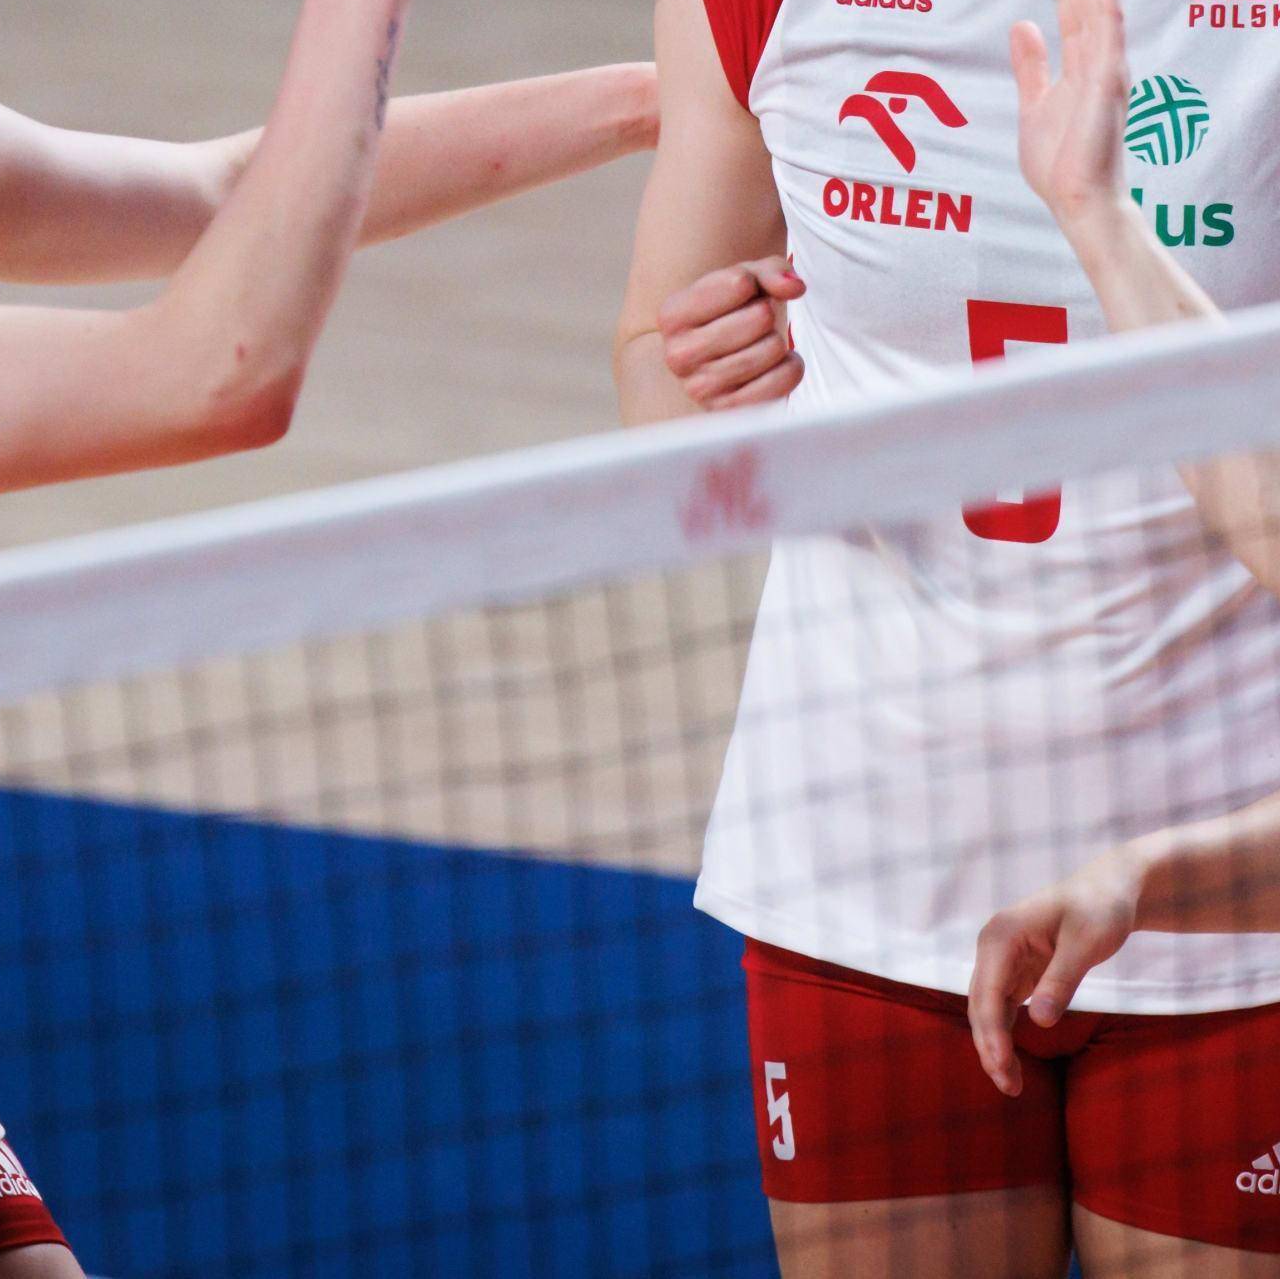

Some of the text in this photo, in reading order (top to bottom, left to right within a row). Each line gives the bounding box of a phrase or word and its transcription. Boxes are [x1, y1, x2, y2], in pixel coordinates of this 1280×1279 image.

[823, 177, 972, 233] ORLEN
[1131, 188, 1235, 247] us
[764, 1061, 796, 1161] 5
